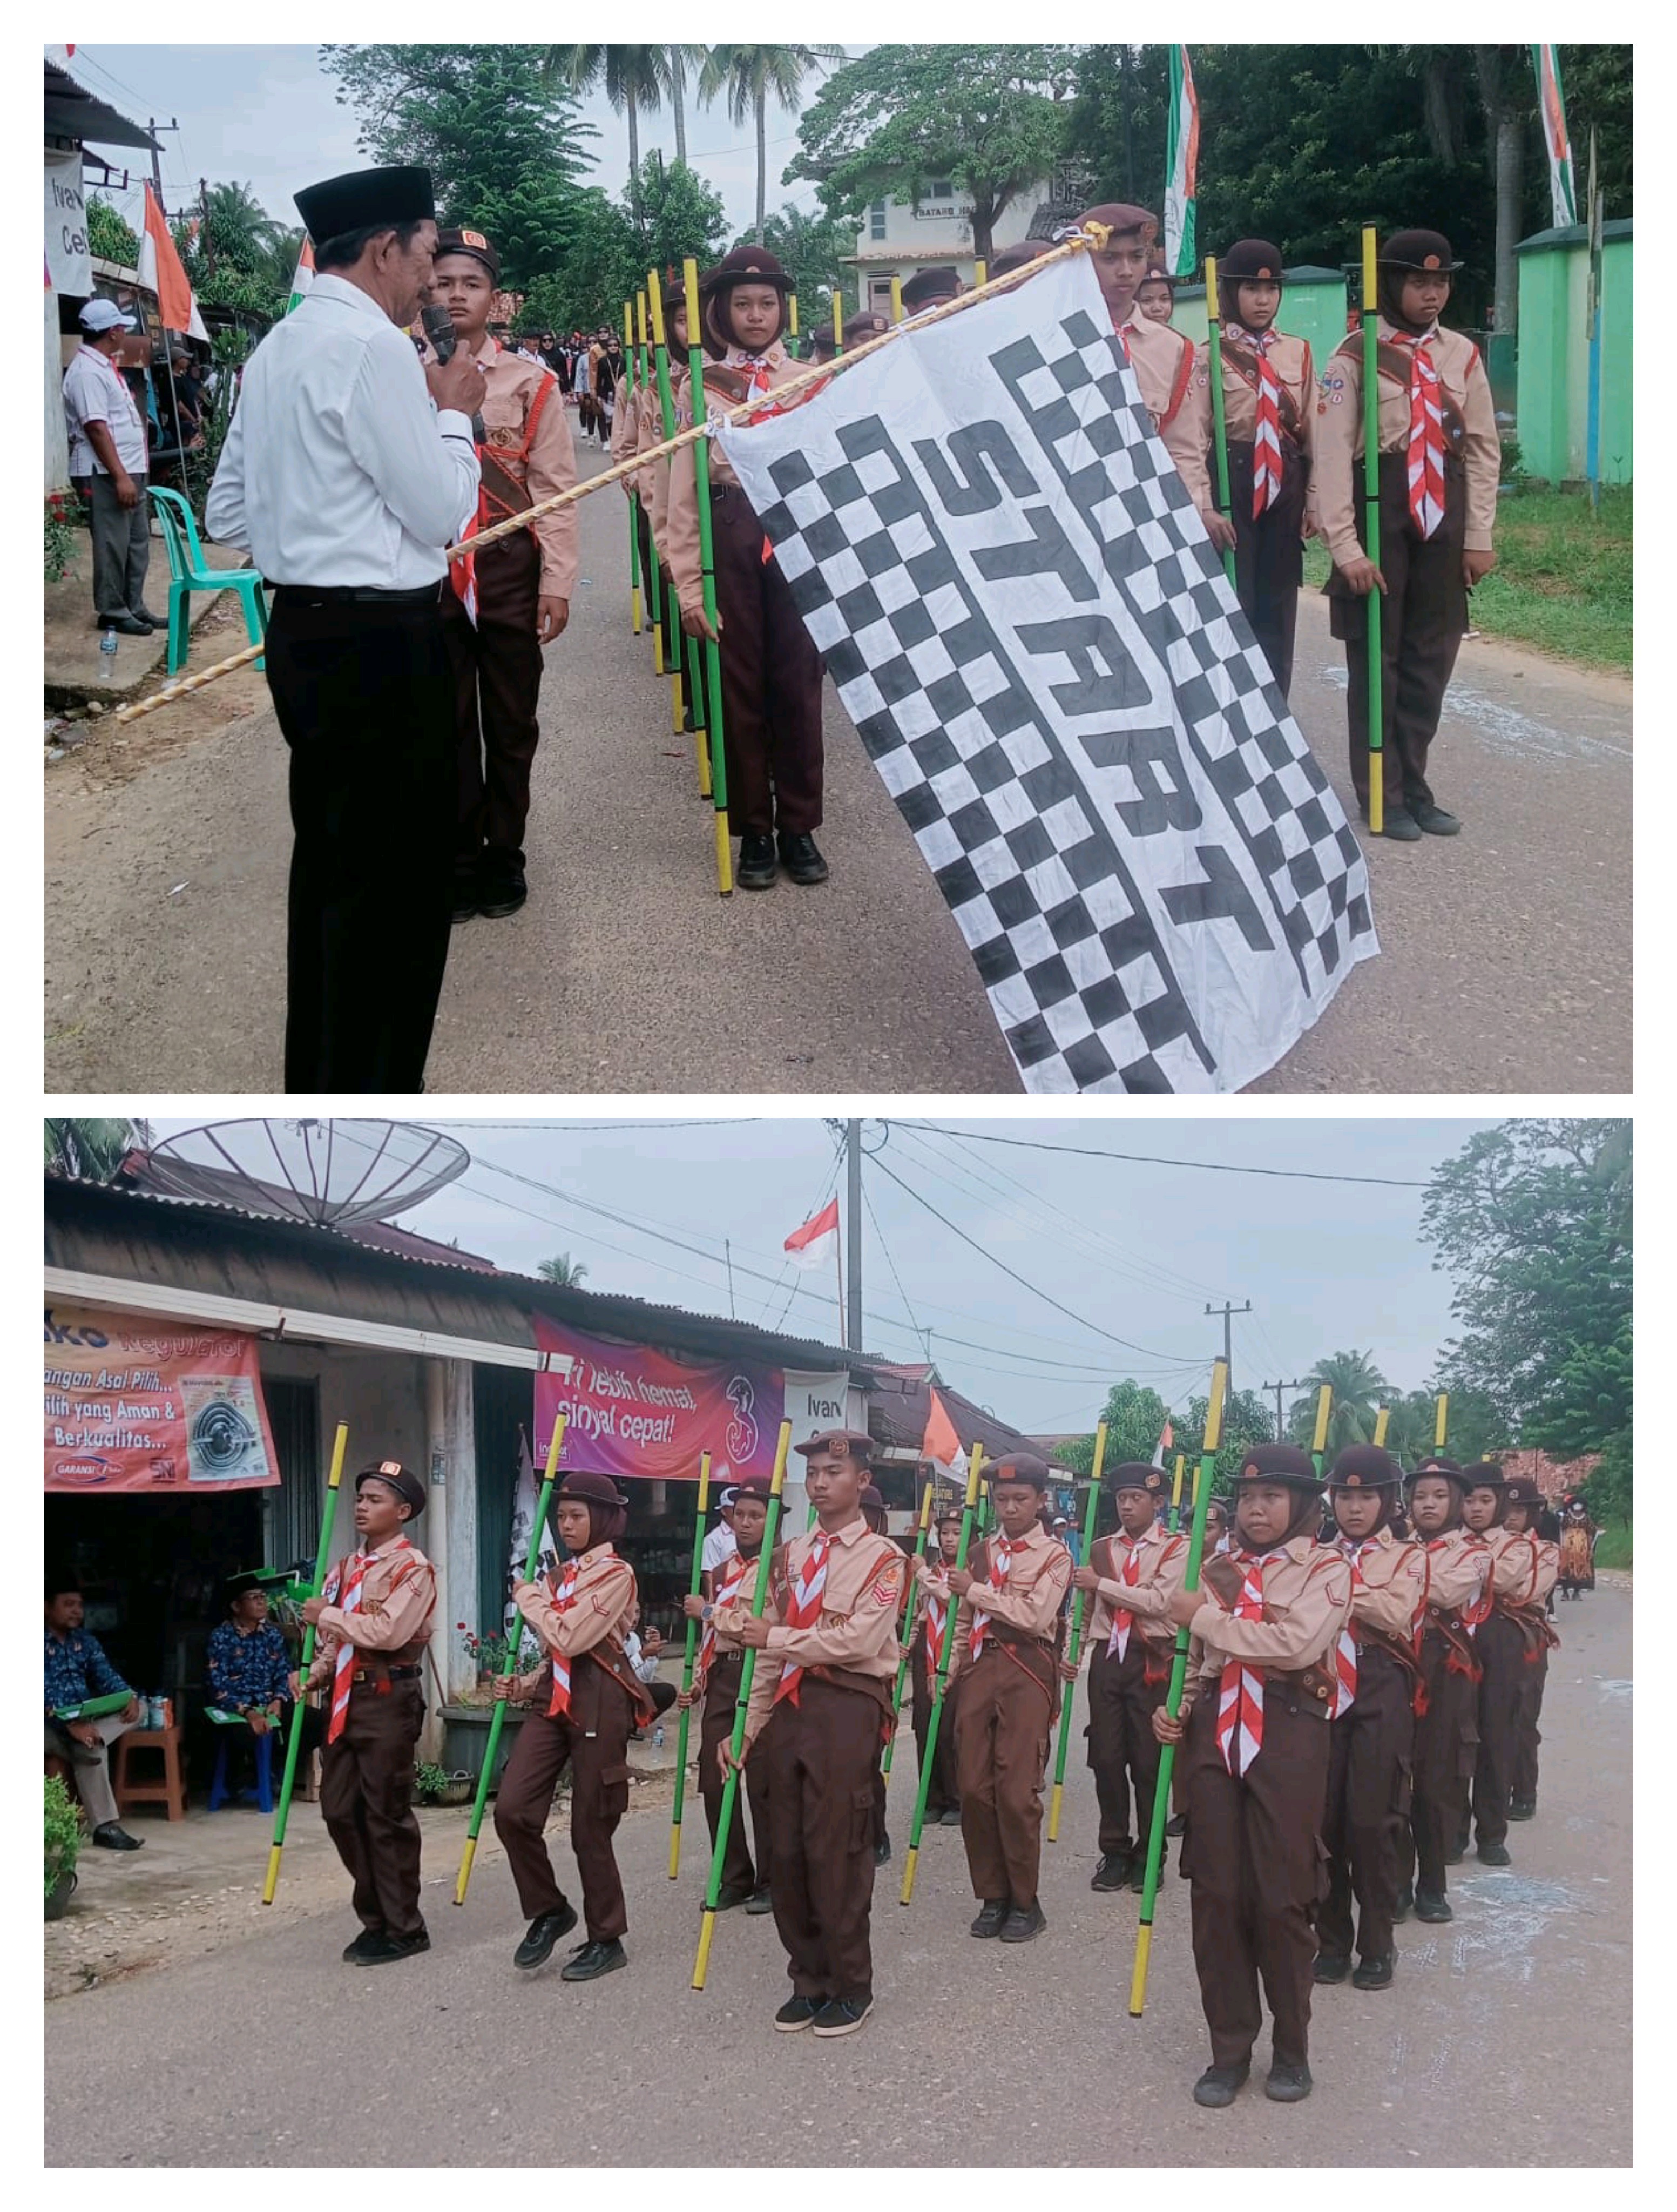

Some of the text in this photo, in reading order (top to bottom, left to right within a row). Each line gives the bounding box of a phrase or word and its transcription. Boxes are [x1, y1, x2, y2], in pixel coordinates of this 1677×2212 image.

[911, 419, 1276, 953] START
[95, 1368, 127, 1391] Asal
[588, 1362, 637, 1401] lebih
[638, 1375, 697, 1414] hemat,
[75, 1402, 112, 1423] yang
[117, 1400, 160, 1420] Aman
[165, 1401, 176, 1420] &
[808, 1393, 842, 1418] Ivan
[558, 1394, 675, 1448] sinyal cepat!
[58, 1464, 96, 1474] GARANSI
